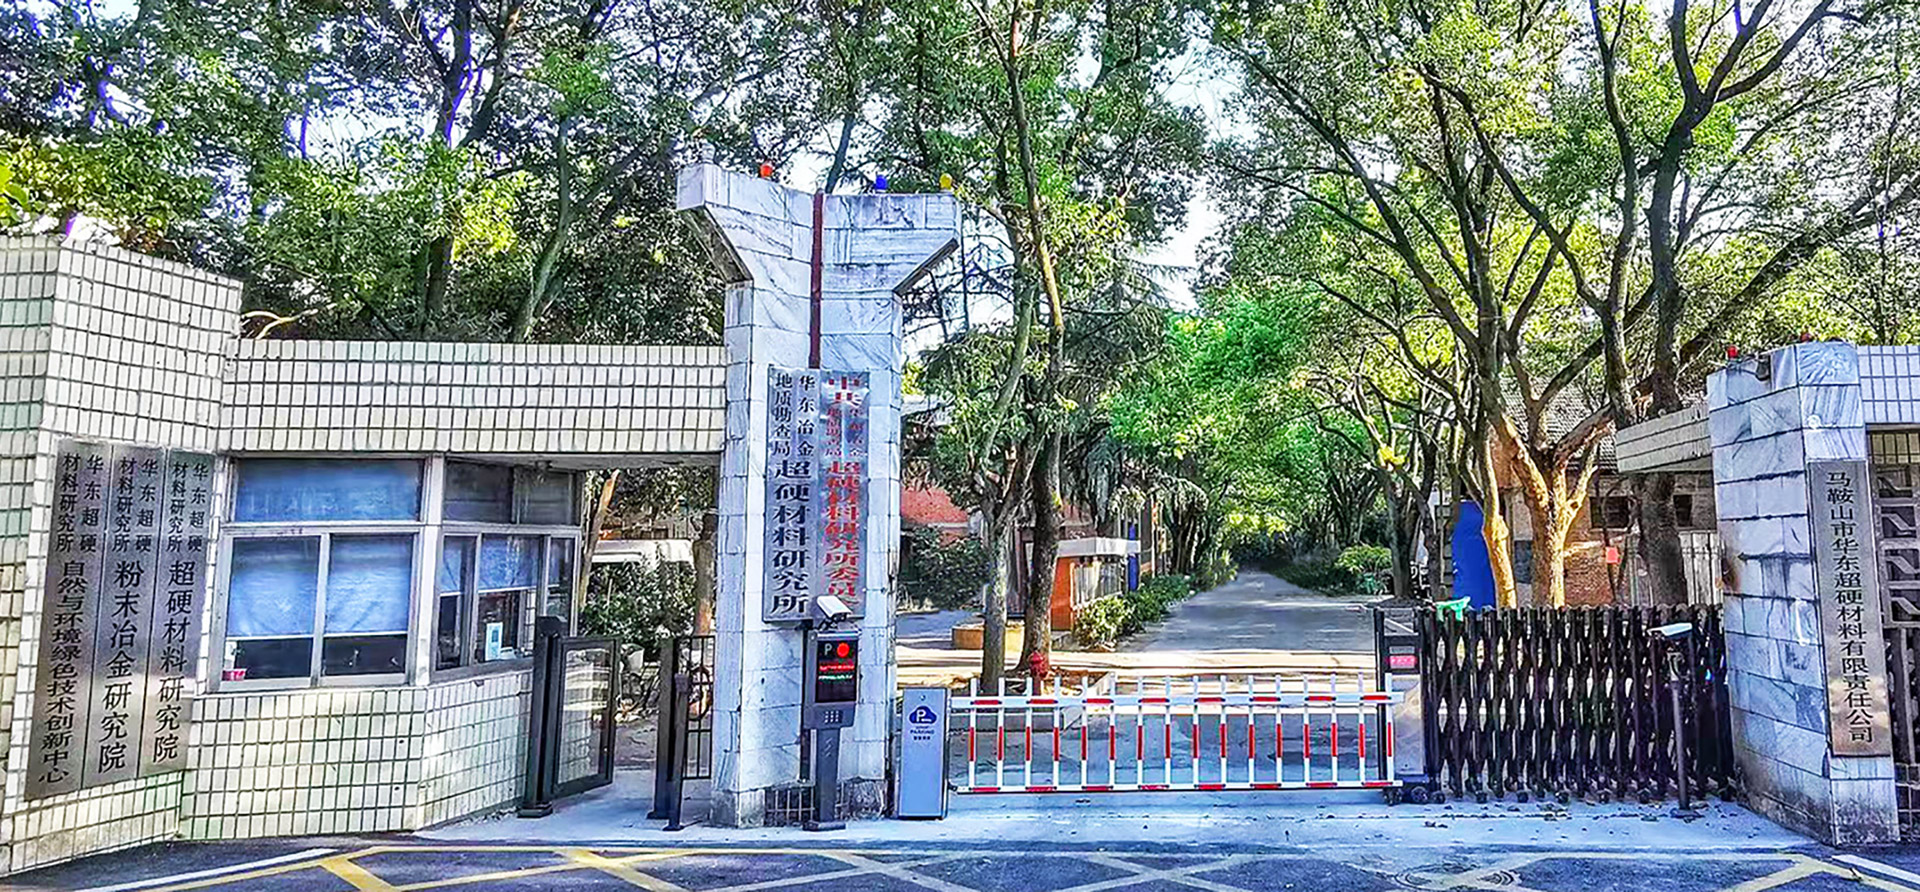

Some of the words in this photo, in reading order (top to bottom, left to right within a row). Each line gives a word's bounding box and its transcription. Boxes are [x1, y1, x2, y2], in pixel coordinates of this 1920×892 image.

[772, 372, 793, 457] 地质勘查局
[797, 374, 816, 457] 华东冶金
[56, 452, 82, 553] 材料研究所
[80, 454, 104, 553] 华东超硬
[111, 456, 137, 553] 材料研究所
[135, 458, 159, 553] 华东超硬
[166, 461, 189, 552] 材料研究所
[187, 462, 209, 552] 华东超硬
[770, 460, 812, 614] 超硬材料研究所
[824, 643, 833, 656] P
[1826, 472, 1873, 743] 马鞍山市华东超硬材料有限责任公司
[39, 560, 88, 783] 自然与环境绿色技术创新中心
[98, 560, 145, 774] 粉末冶金研究院
[152, 560, 196, 763] 超硬材料研究院
